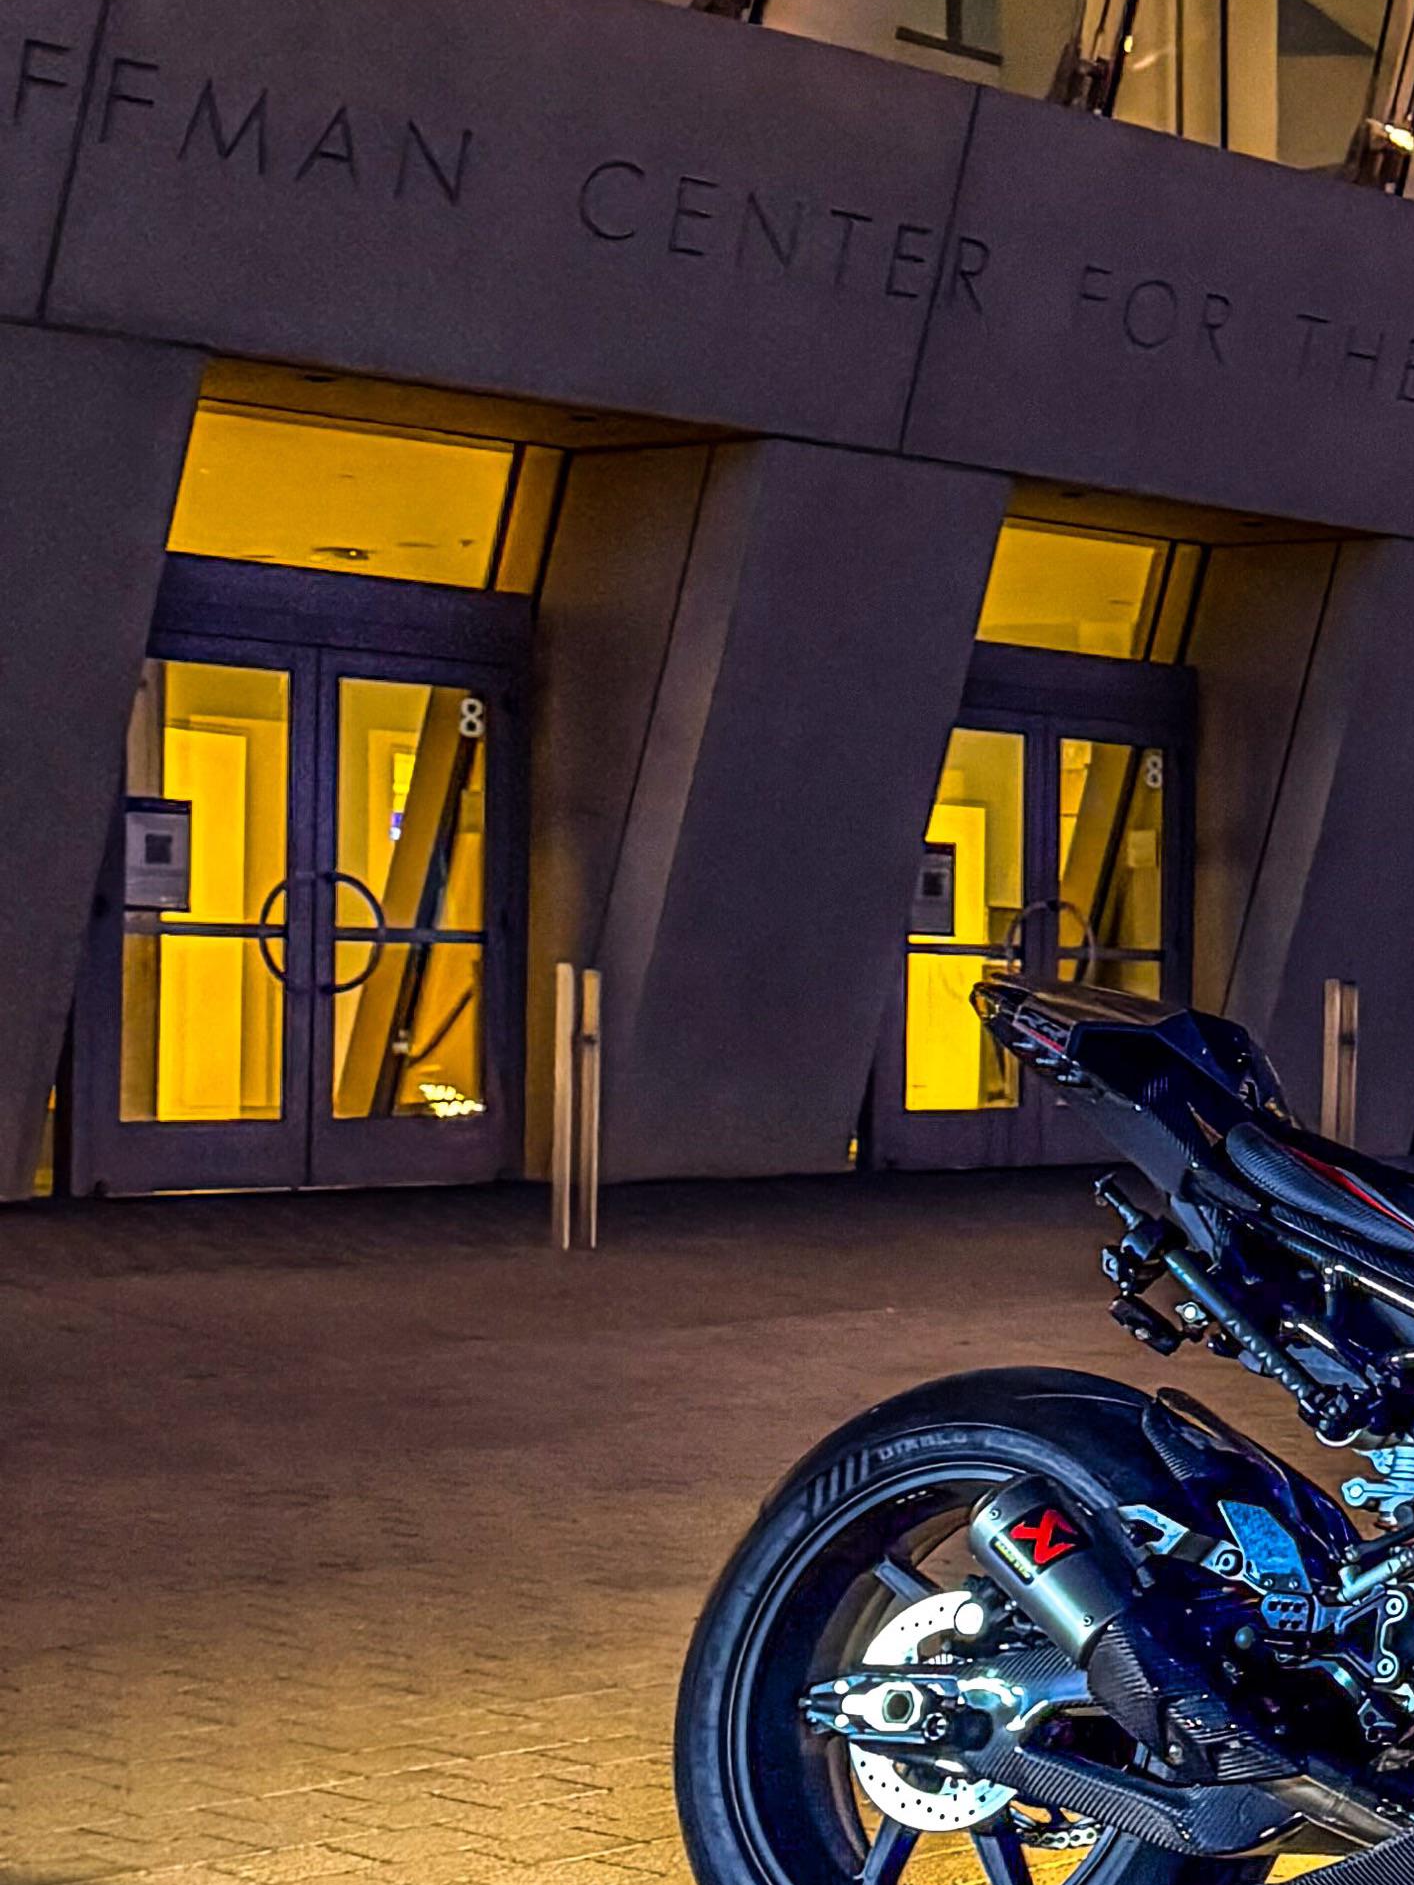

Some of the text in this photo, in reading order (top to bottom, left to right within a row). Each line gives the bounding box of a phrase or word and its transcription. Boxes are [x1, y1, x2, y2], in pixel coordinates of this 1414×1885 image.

[13, 39, 474, 206] FFMAN
[578, 159, 991, 312] CENTER
[1079, 265, 1231, 364] FOR
[460, 698, 484, 738] 8
